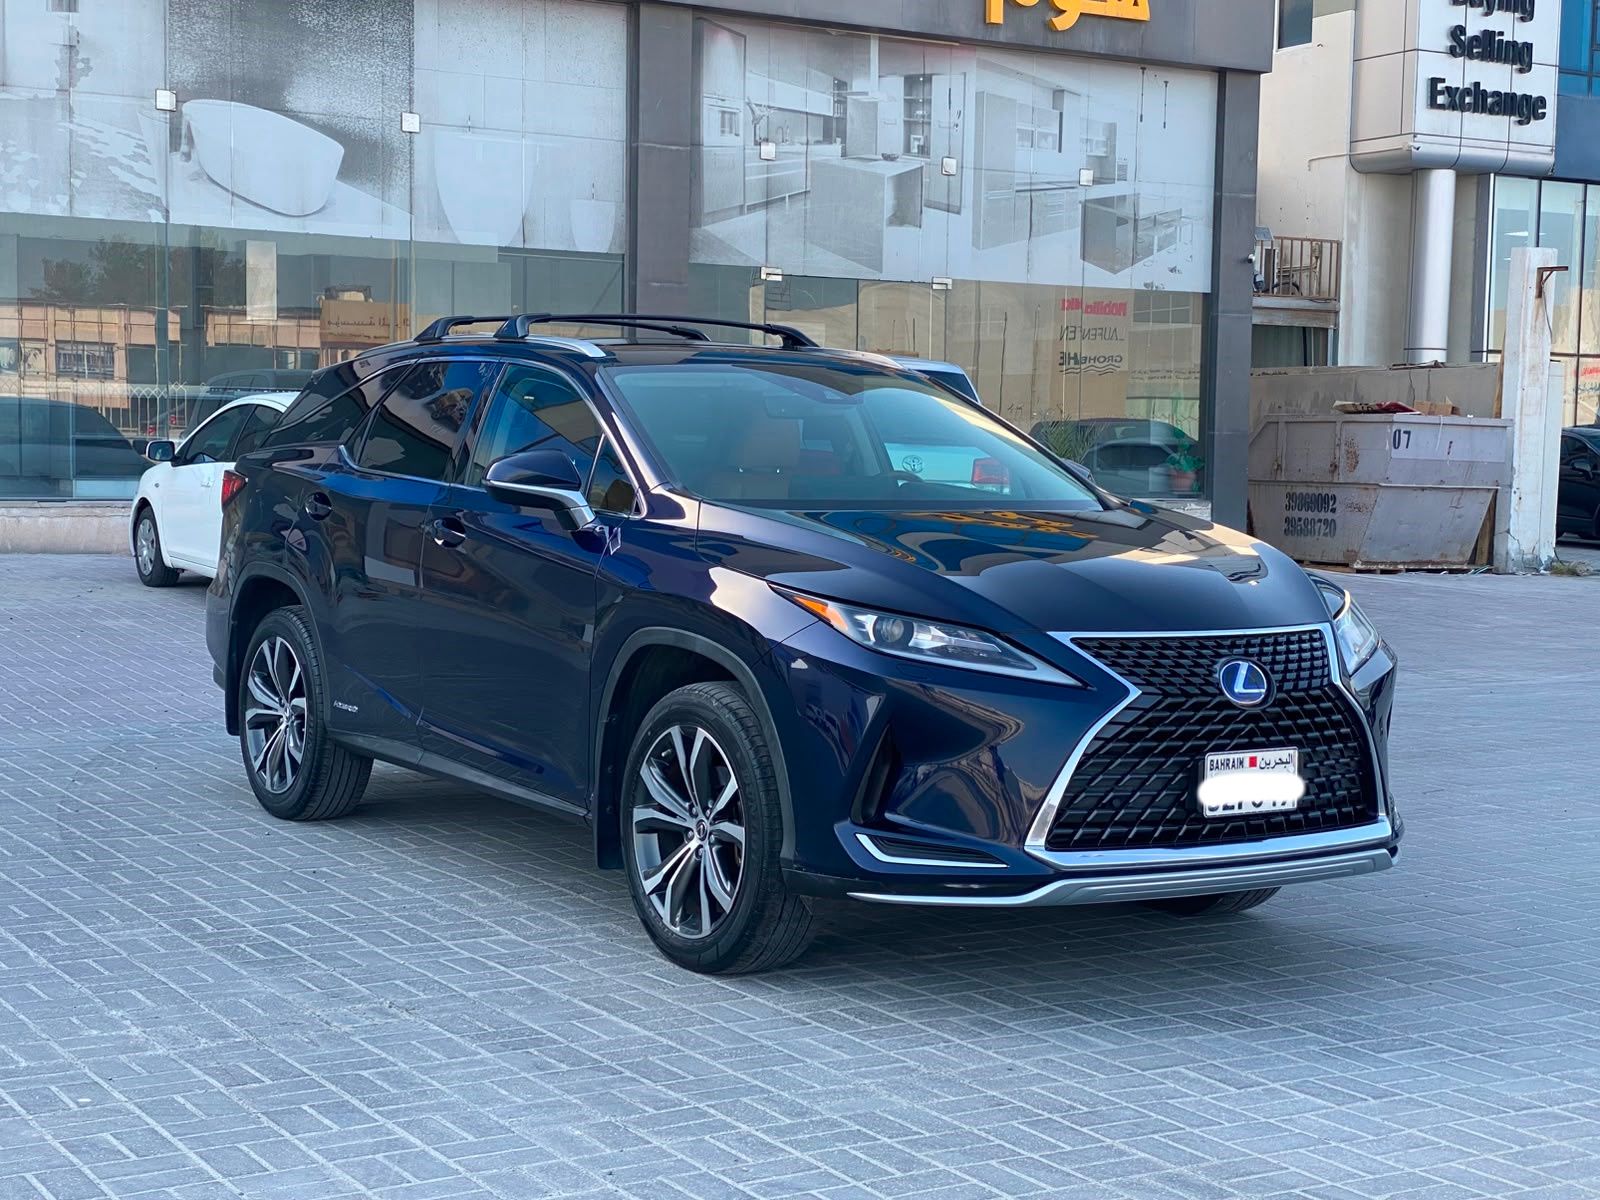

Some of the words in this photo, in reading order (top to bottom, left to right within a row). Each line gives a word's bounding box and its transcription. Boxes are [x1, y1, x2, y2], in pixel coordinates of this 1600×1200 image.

[1448, 24, 1533, 74] Selling
[1428, 77, 1547, 125] Exchange
[1393, 429, 1411, 449] 07
[1209, 757, 1244, 771] BAHRAIN
[1259, 753, 1293, 769] البحرين
